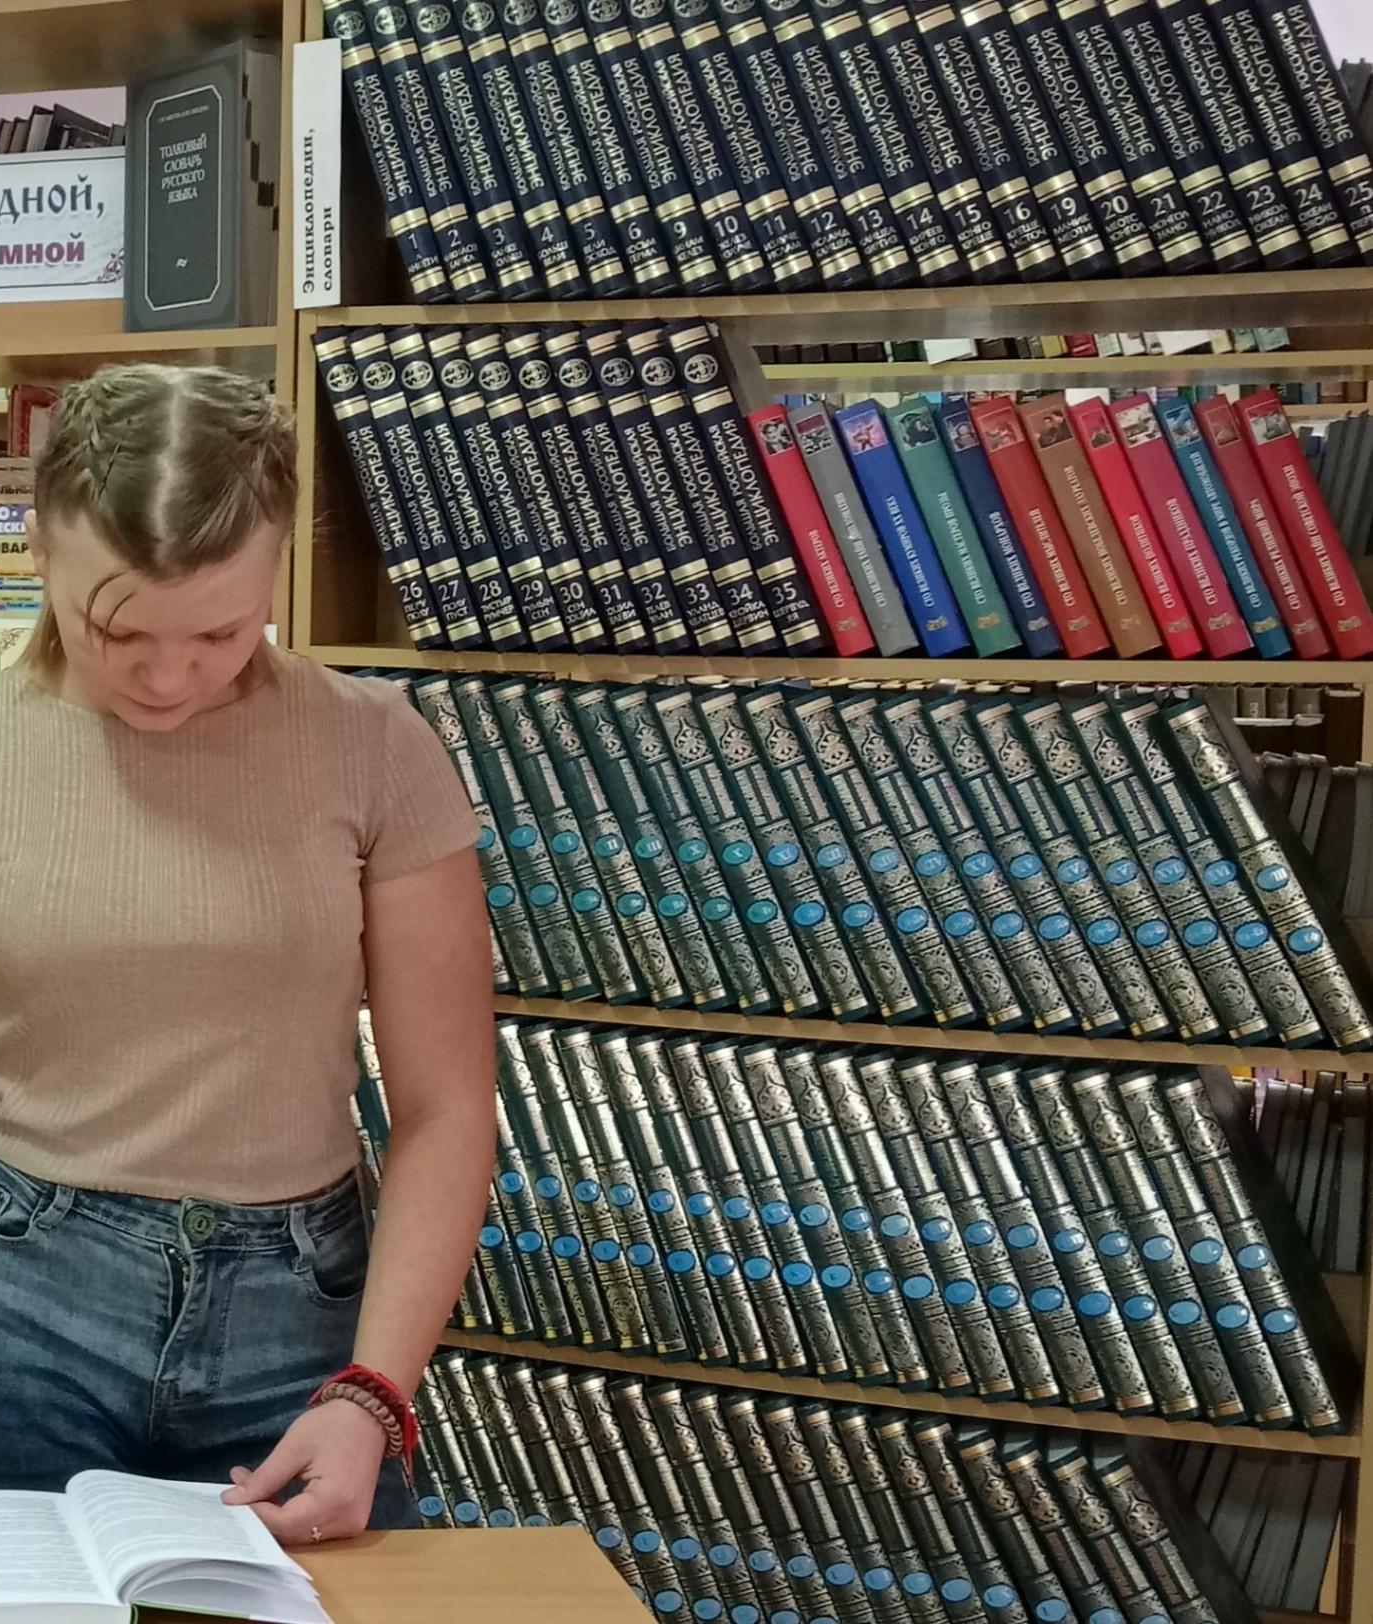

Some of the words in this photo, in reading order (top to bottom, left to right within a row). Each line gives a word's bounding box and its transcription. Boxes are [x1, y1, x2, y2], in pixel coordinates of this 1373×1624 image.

[1188, 13, 1254, 147] ЭНЦИКЛОПЕДИЯ
[1236, 10, 1302, 144] ЭНЦИКЛОПЕДИЯ
[1287, 5, 1353, 142] ЭНЦИКЛОПЕДИЯ
[994, 30, 1058, 160] ЭНЦИКЛОПЕДИЯ
[1041, 27, 1106, 159] ЭНЦИКЛОПЕДИЯ
[1090, 24, 1155, 155] ЭНЦИКЛОПЕДИЯ
[1138, 21, 1204, 153] ЭНЦИКЛОПЕДИЯ
[760, 49, 818, 175] ЭНЦИКЛОПЕДИЯ
[806, 45, 865, 173] ЭНЦИКЛОПЕДИЯ
[854, 43, 914, 172] ЭНЦИКЛОПЕДИЯ
[901, 39, 962, 168] ЭНЦИКЛОПЕДИЯ
[949, 36, 1010, 165] ЭНЦИКЛОПЕДИЯ
[494, 65, 544, 190] ЭНЦИКЛОПЕДИЯ
[537, 60, 587, 185] ЭНЦИКЛОПЕДИЯ
[580, 60, 631, 185] ЭНЦИКЛОПЕДИЯ
[625, 58, 676, 184] ЭНЦИКЛОПЕДИЯ
[668, 53, 722, 179] ЭНЦИКЛОПЕДИЯ
[713, 52, 770, 178] ЭНЦИКЛОПЕДИЯ
[366, 74, 412, 196] ЭНЦИКЛОПЕДИЯ
[406, 69, 452, 192] ЭНЦИКЛОПЕДИЯ
[450, 67, 497, 190] ЭНЦИКЛОПЕДИЯ
[160, 133, 207, 158] ТОЛКОВЫЙ
[164, 154, 202, 172] СЛОВАРЬ
[162, 169, 205, 190] РУССКОГО
[168, 187, 198, 203] ЯЗЫКА
[1101, 195, 1129, 219] 20
[1150, 193, 1176, 216] 21
[1198, 191, 1226, 216] 22
[1247, 185, 1275, 210] 23
[1294, 183, 1323, 208] 24
[1345, 181, 1373, 207] 25
[303, 129, 315, 293] Энциклопедии,
[858, 210, 883, 231] 13
[907, 207, 934, 230] 14
[955, 203, 982, 227] 15
[1004, 202, 1031, 224] 16
[1051, 197, 1077, 220] 19
[541, 226, 554, 243] 4
[583, 223, 595, 240] 5
[627, 222, 642, 240] 6
[674, 222, 687, 239] 9
[715, 215, 739, 237] 10
[763, 215, 787, 235] 11
[811, 211, 837, 233] 12
[0, 232, 85, 264] мной
[324, 207, 334, 291] словари
[407, 234, 419, 249] 1
[448, 229, 461, 247] 2
[493, 228, 505, 245] 3
[359, 426, 407, 547] ЭНЦИКЛОПЕДИЯ
[397, 424, 446, 546] ЭНЦИКЛОПЕДИЯ
[435, 423, 486, 545] ЭНЦИКЛОПЕДИЯ
[476, 423, 528, 545] ЭНЦИКЛОПЕДИЯ
[514, 425, 566, 547] ЭНЦИКЛОПЕДИЯ
[554, 424, 608, 548] ЭНЦИКЛОПЕДИЯ
[595, 423, 649, 547] ЭНЦИКЛОПЕДИЯ
[637, 422, 693, 547] ЭНЦИКЛОПЕДИЯ
[679, 422, 736, 548] ЭНЦИКЛОПЕДИЯ
[722, 419, 779, 546] ЭНЦИКЛОПЕДИЯ
[989, 509, 1015, 555] МОНАРХОВ
[909, 558, 929, 592] ВЕЛИКИХ
[1006, 553, 1029, 592] ВЕЛИКИХ
[1187, 548, 1211, 588] ВЕЛИКИХ
[399, 581, 422, 602] 26
[438, 580, 459, 601] 27
[479, 580, 501, 601] 28
[521, 580, 543, 601] 29
[560, 582, 583, 603] 30
[600, 584, 622, 604] 31
[641, 582, 666, 604] 32
[685, 583, 710, 605] 33
[728, 584, 753, 605] 34
[772, 582, 797, 605] 35
[921, 591, 935, 607] СТО
[1020, 591, 1035, 609] СТО
[1202, 586, 1218, 605] СТО
[1331, 589, 1347, 607] СТО
